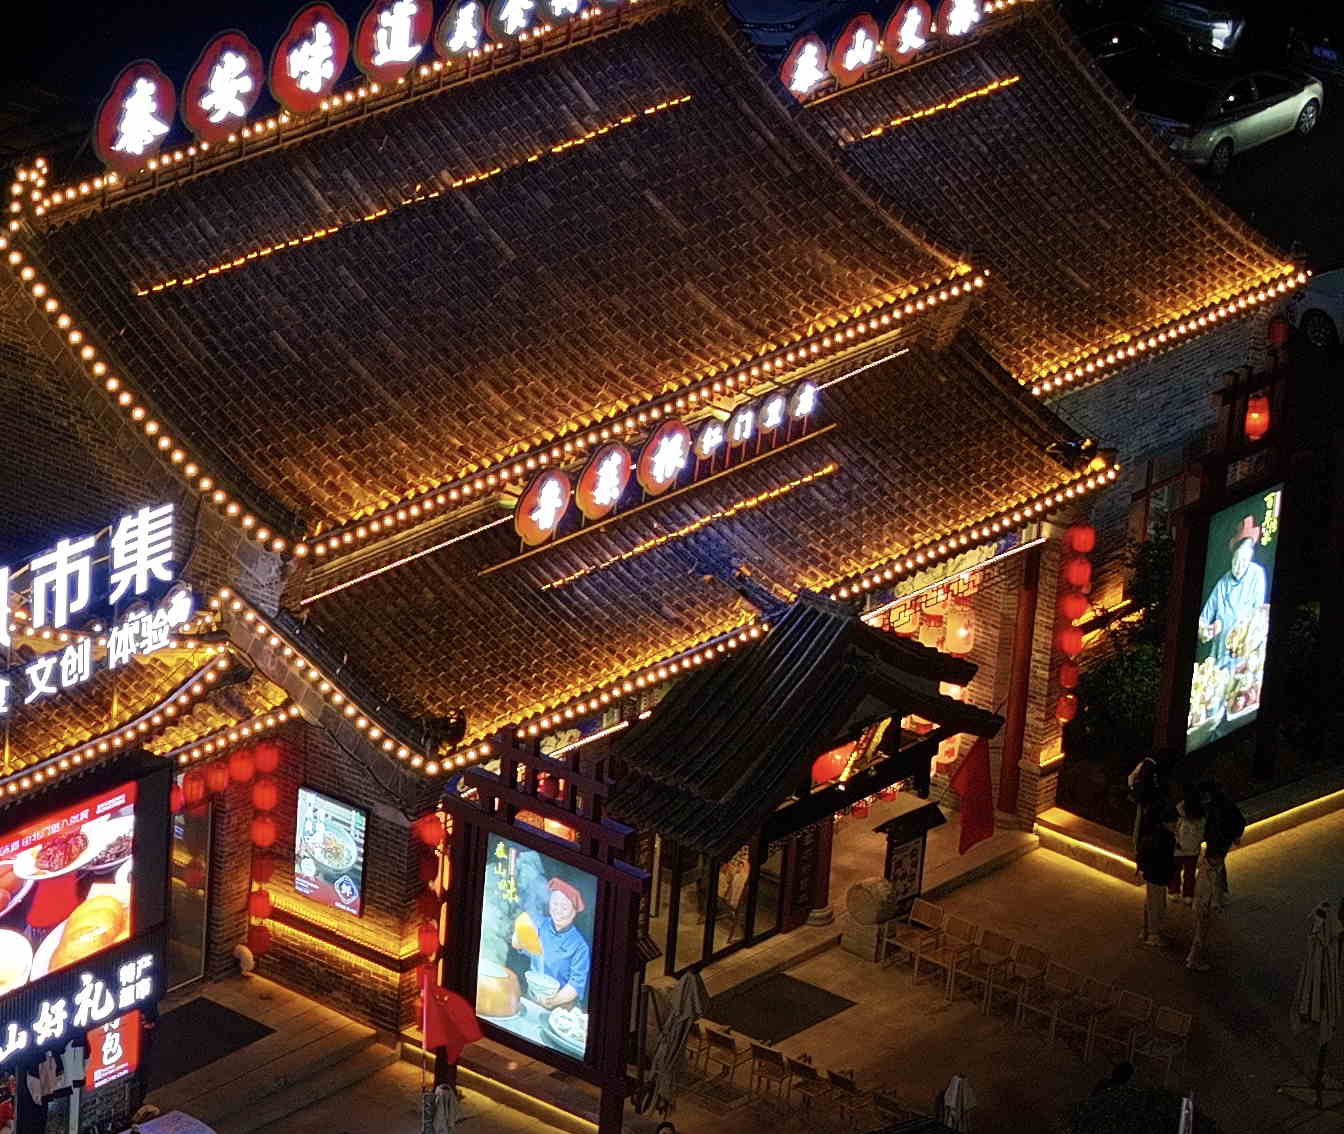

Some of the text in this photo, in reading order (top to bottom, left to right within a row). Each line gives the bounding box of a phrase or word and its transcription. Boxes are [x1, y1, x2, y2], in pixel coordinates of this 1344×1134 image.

[111, 0, 422, 155] 泰安味道
[24, 641, 91, 705] 文创
